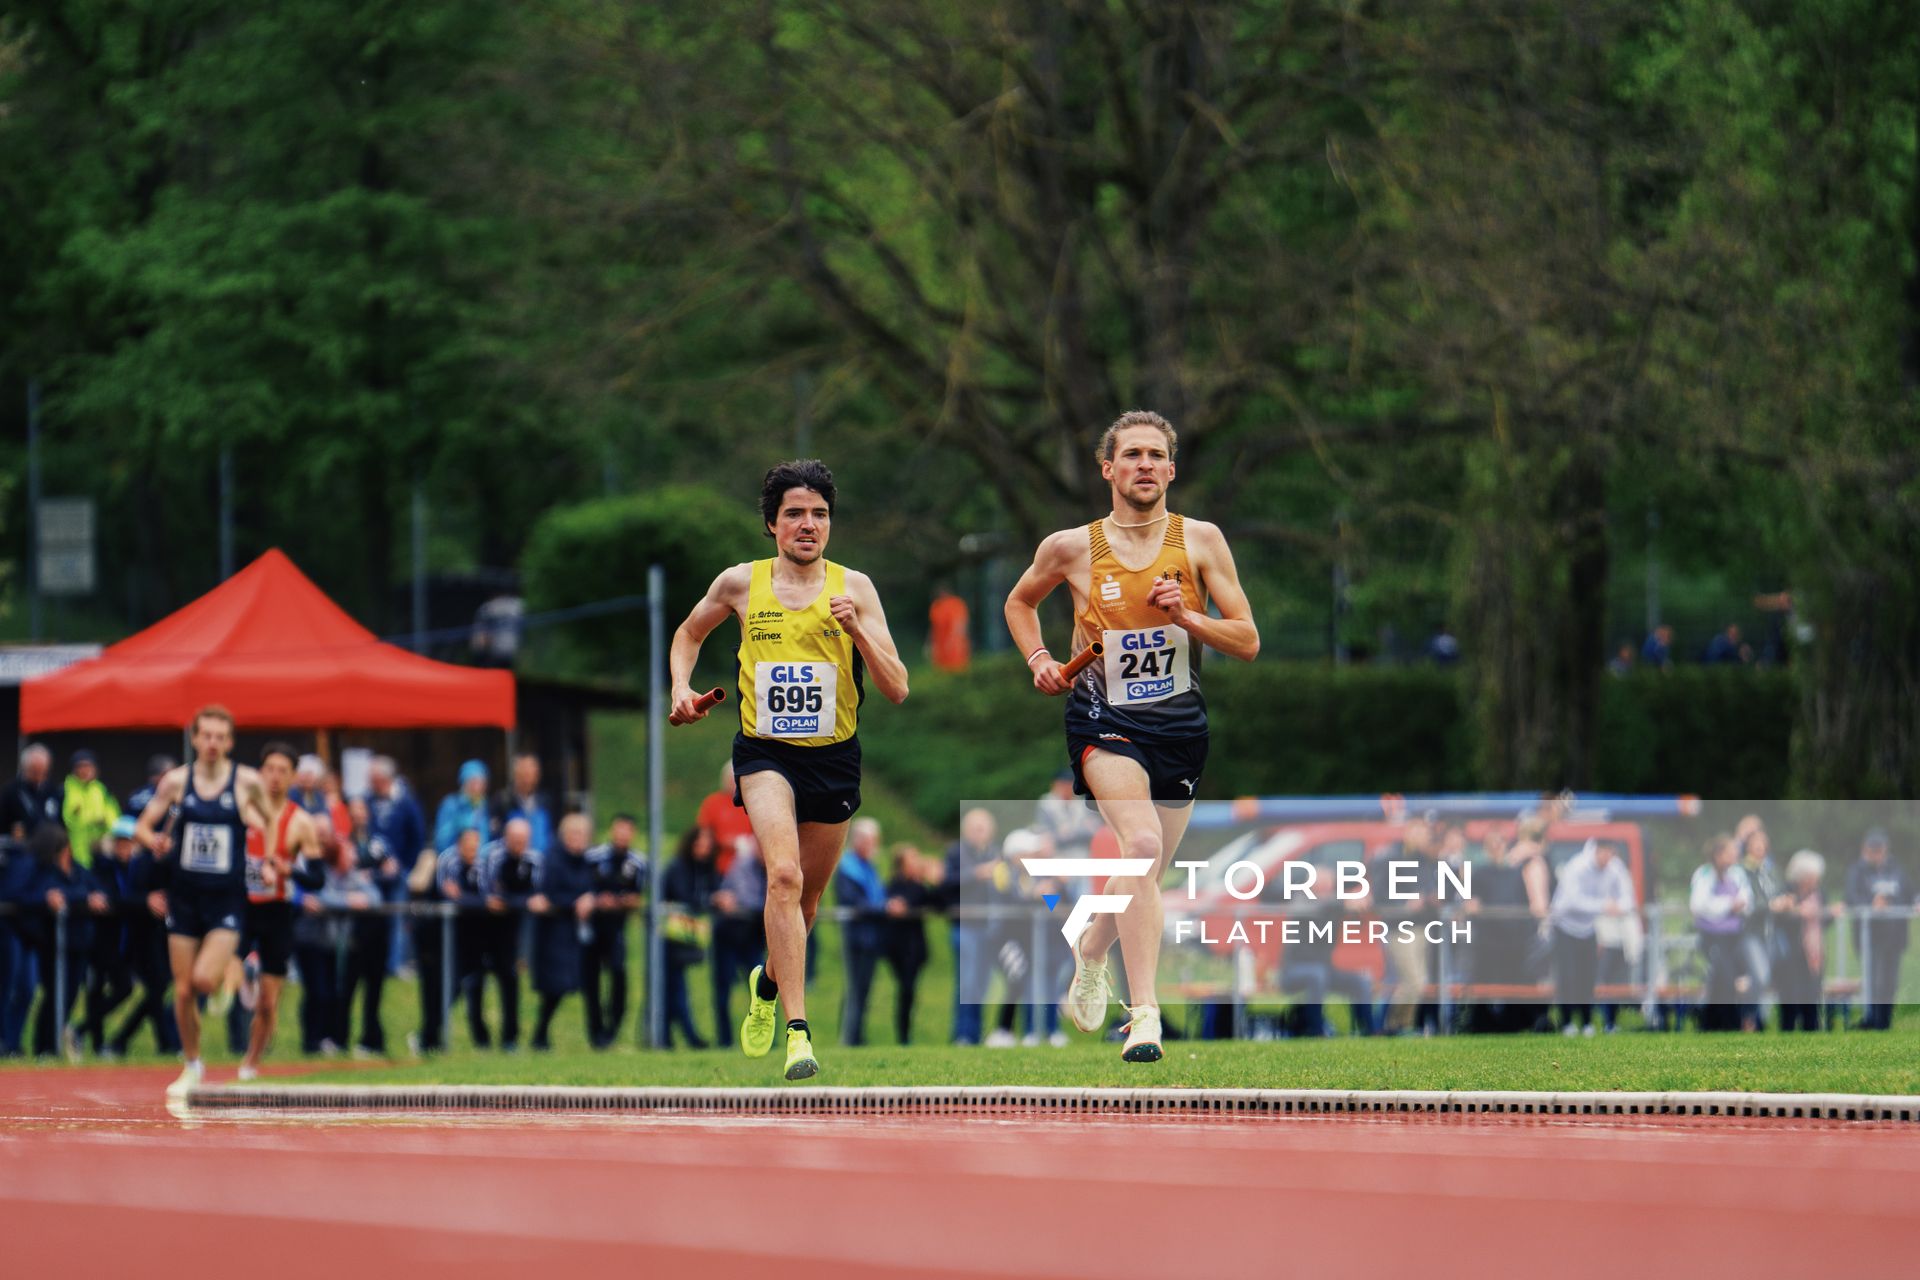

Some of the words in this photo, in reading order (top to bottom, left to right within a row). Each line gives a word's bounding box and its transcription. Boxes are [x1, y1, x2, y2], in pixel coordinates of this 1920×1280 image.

[752, 632, 782, 641] infinex
[1119, 646, 1176, 680] 247
[1147, 679, 1172, 692] PLAN
[768, 686, 822, 713] 695
[791, 718, 817, 727] PLAN
